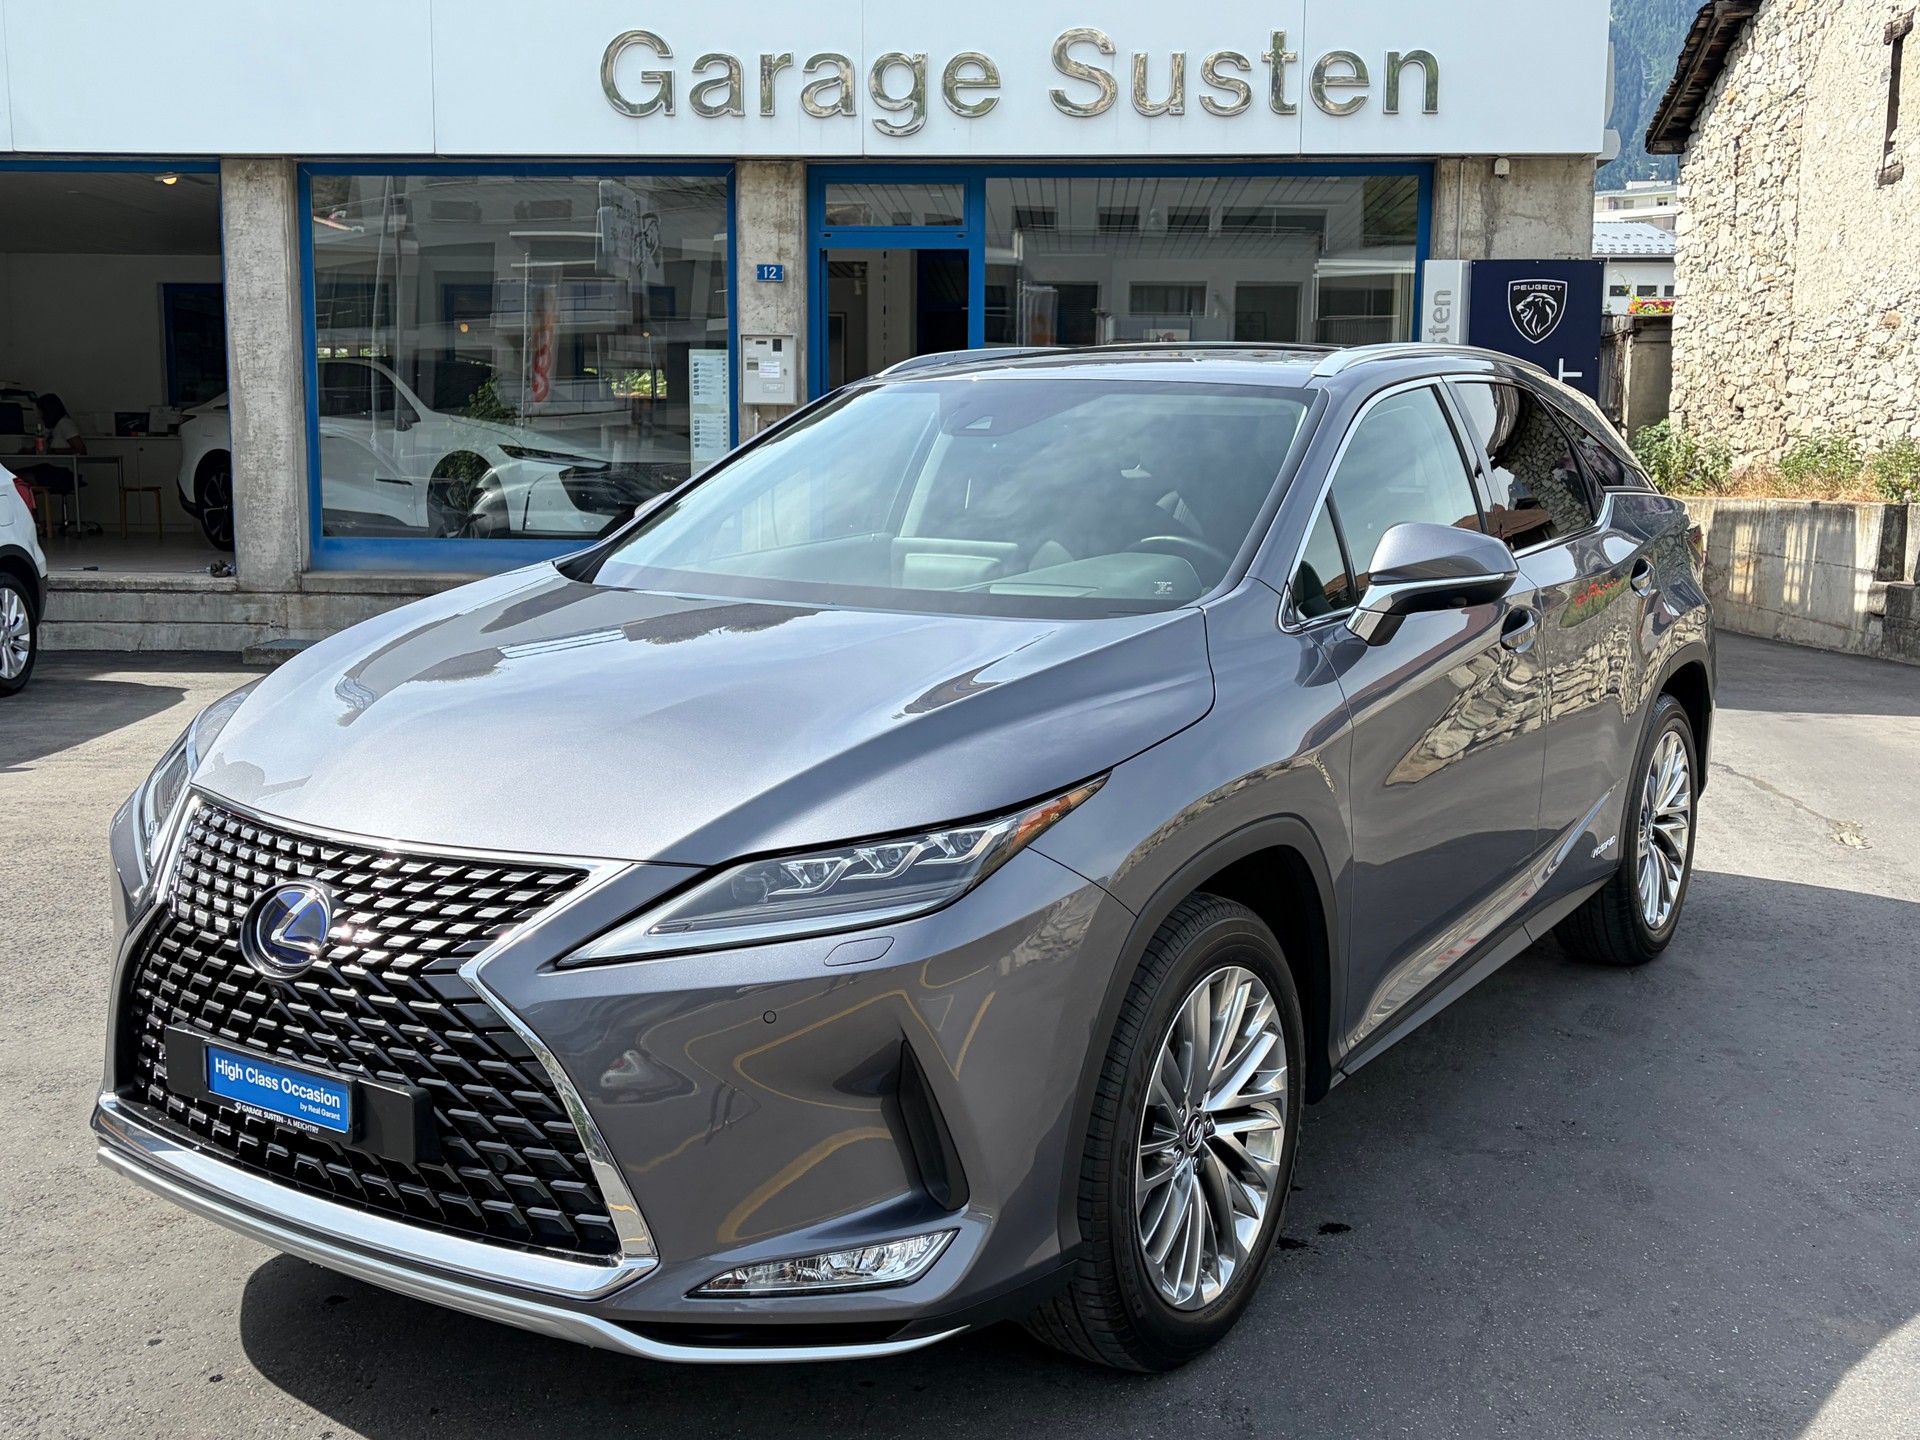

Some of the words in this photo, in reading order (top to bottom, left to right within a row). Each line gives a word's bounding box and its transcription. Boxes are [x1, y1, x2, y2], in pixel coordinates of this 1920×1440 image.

[599, 28, 1003, 137] Garage
[1049, 27, 1439, 117] Susten
[763, 266, 777, 279] 12
[215, 1058, 243, 1081] High
[245, 1067, 279, 1091] Class
[281, 1078, 341, 1109] Occasion
[242, 1104, 262, 1117] GARAGE
[263, 1112, 283, 1124] SUSTEN
[300, 1102, 308, 1112] by
[308, 1104, 321, 1115] Real
[321, 1109, 341, 1121] Garant
